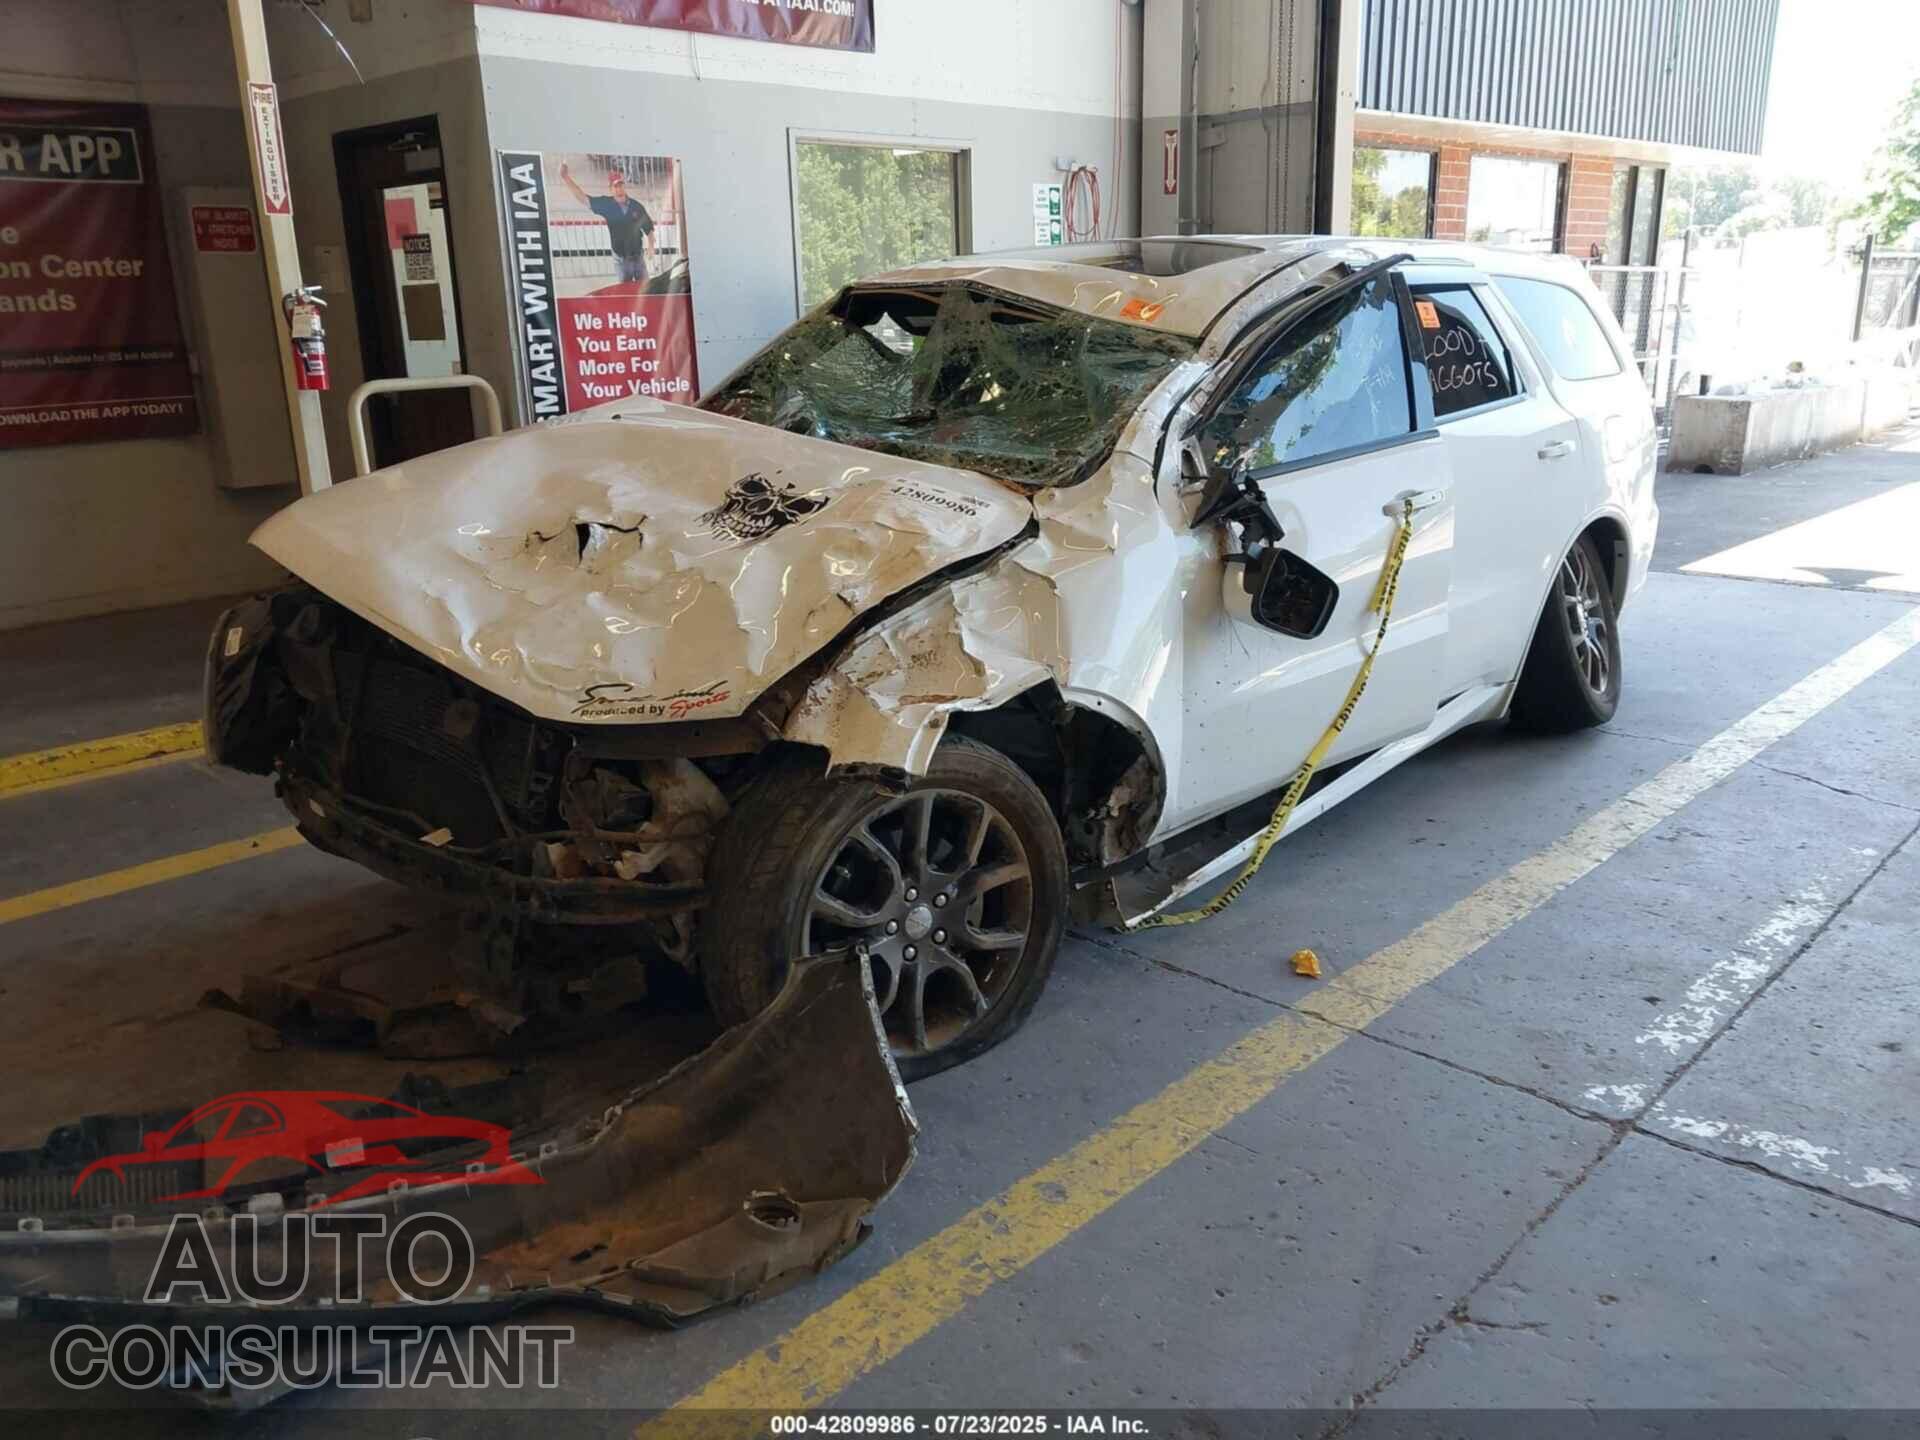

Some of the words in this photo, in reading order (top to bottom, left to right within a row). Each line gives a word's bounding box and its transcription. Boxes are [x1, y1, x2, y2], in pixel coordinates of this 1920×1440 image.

[40, 133, 122, 174] APP
[260, 106, 281, 201] EXTINGUISHER
[509, 162, 540, 219] IAA
[40, 254, 144, 279] Center
[516, 231, 549, 316] WITH
[573, 313, 603, 331] We
[607, 311, 648, 332] Help
[576, 336, 612, 354] You
[616, 334, 657, 352] Earn
[527, 323, 561, 423] MART
[579, 359, 626, 377] More
[631, 356, 660, 374] For
[581, 382, 623, 399] Your
[627, 376, 691, 396] Vehicle
[71, 408, 99, 421] THE
[102, 406, 130, 418] APP
[130, 403, 184, 416] TODAY!
[649, 704, 667, 717] by
